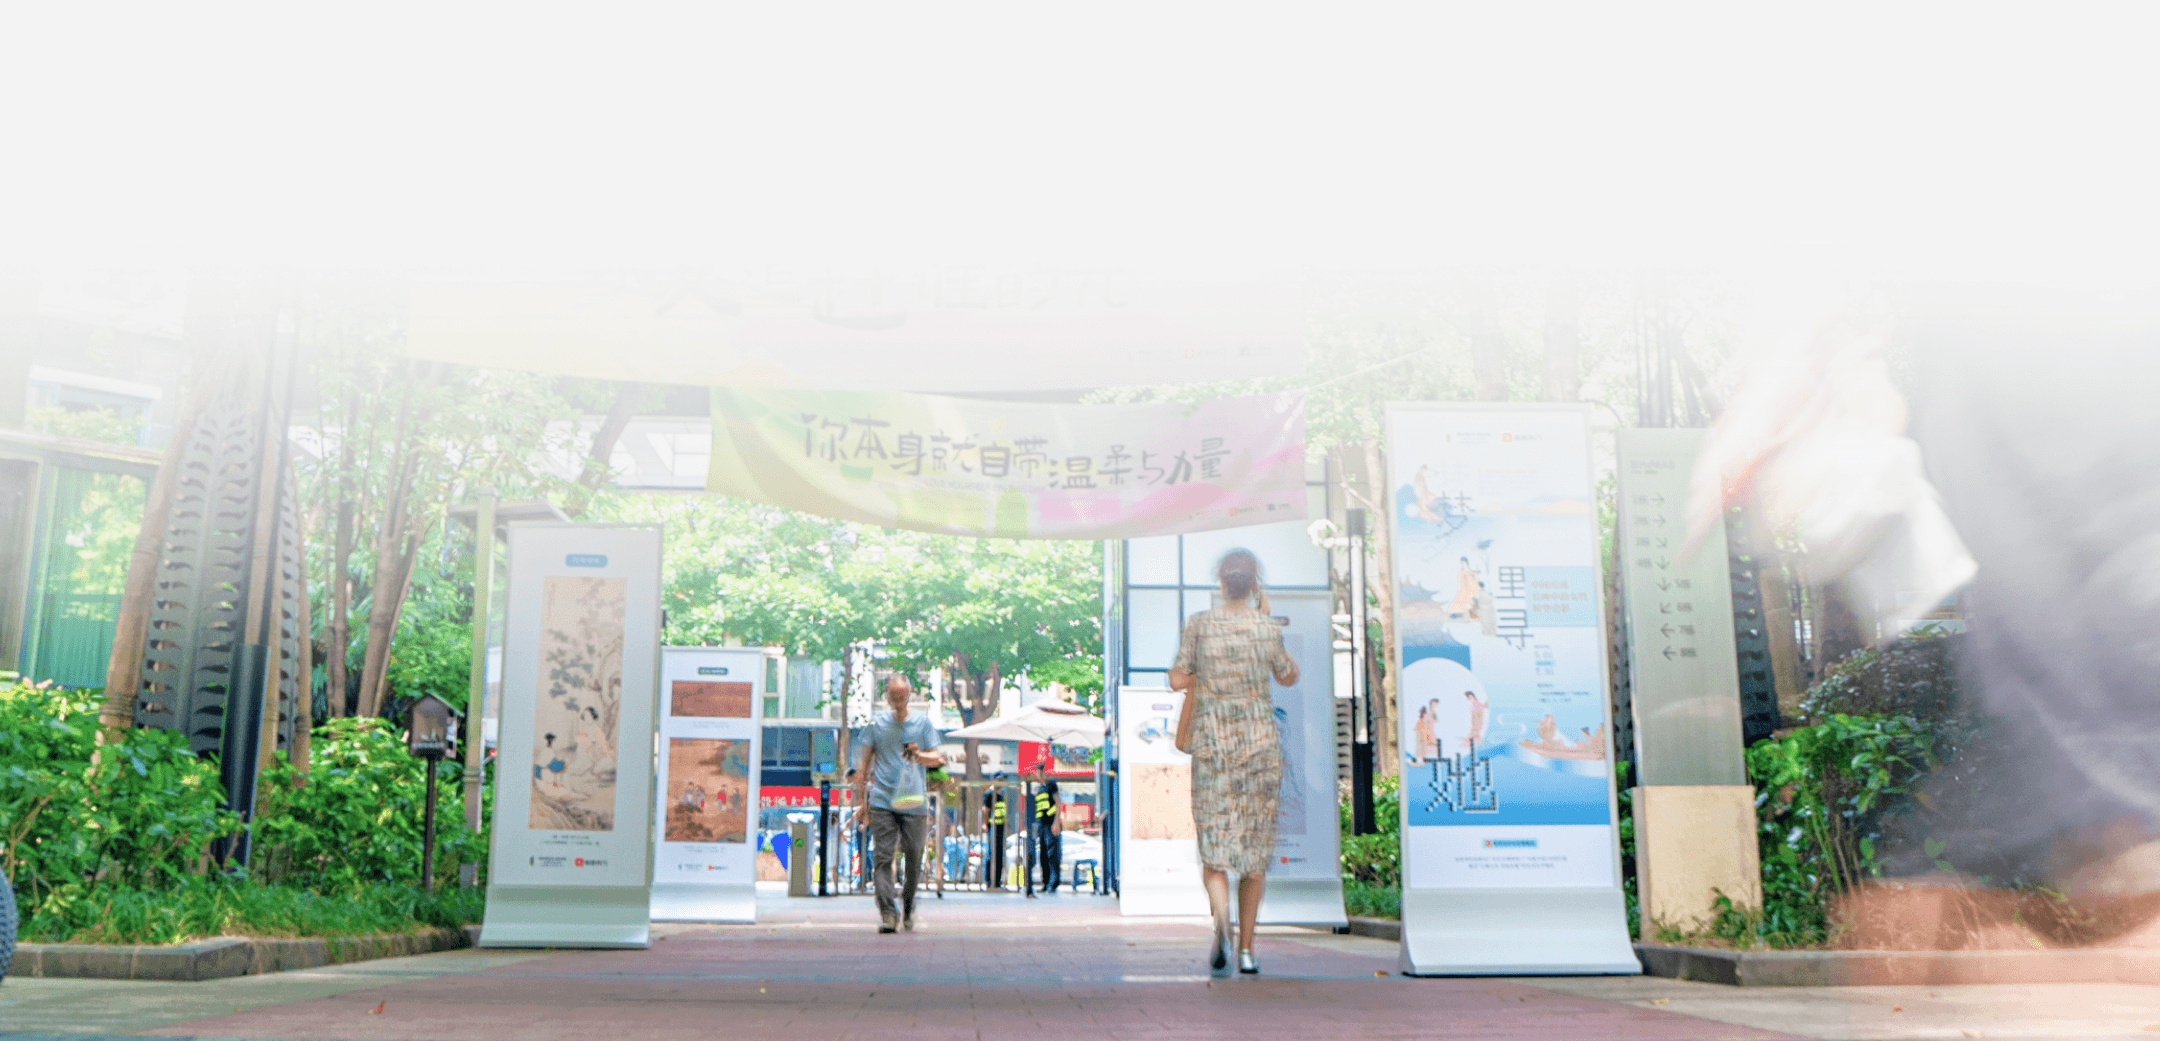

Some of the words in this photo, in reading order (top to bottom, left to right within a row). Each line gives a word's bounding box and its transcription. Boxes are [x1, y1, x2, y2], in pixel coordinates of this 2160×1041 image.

[801, 412, 1233, 490] 你本身就自带温柔与力量
